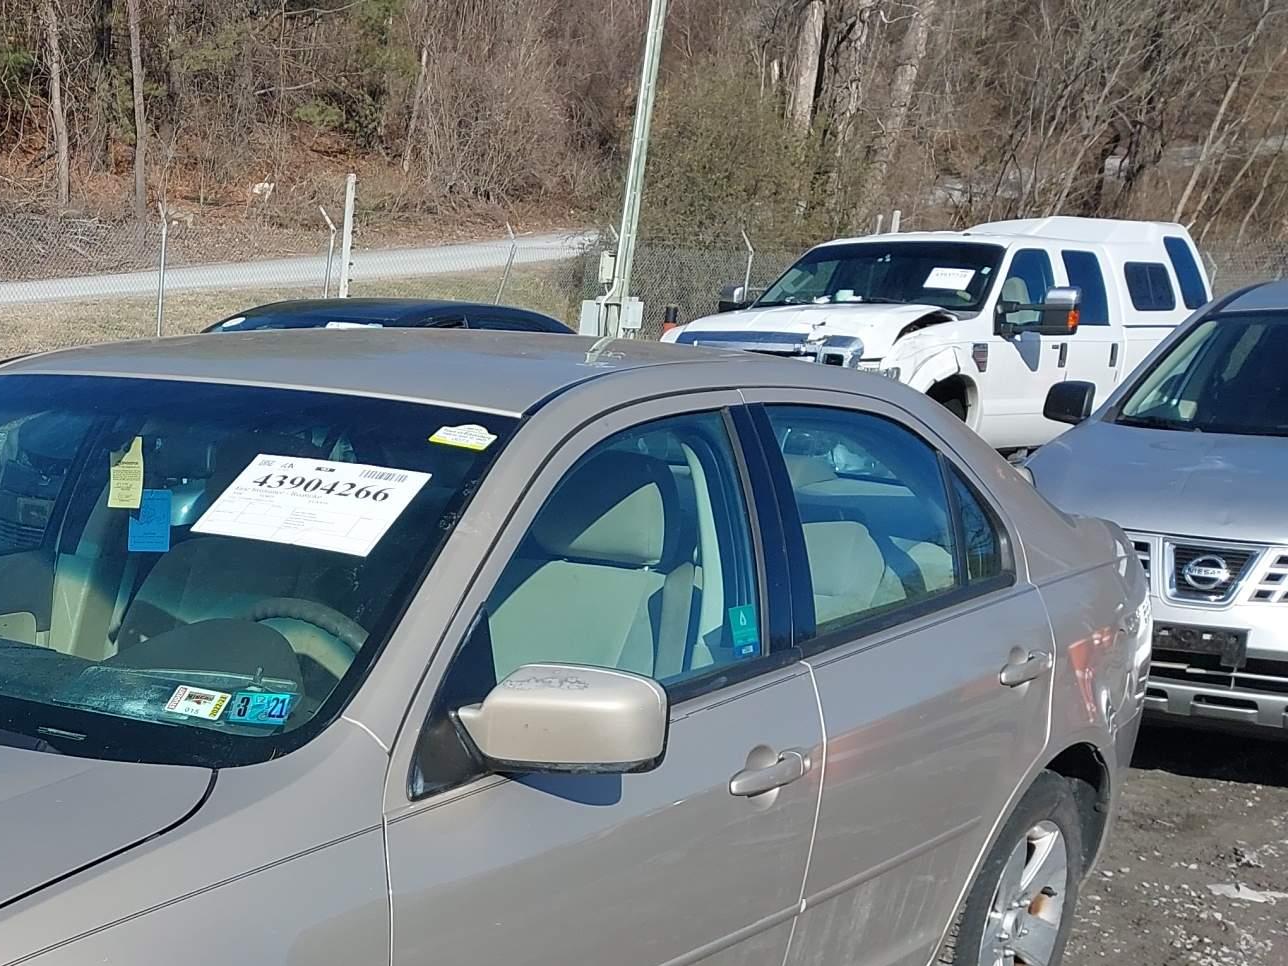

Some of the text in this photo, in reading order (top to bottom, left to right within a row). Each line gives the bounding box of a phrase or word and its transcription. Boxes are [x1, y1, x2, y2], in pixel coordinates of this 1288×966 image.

[253, 473, 395, 502] 43904266
[237, 697, 287, 718] 3 21
